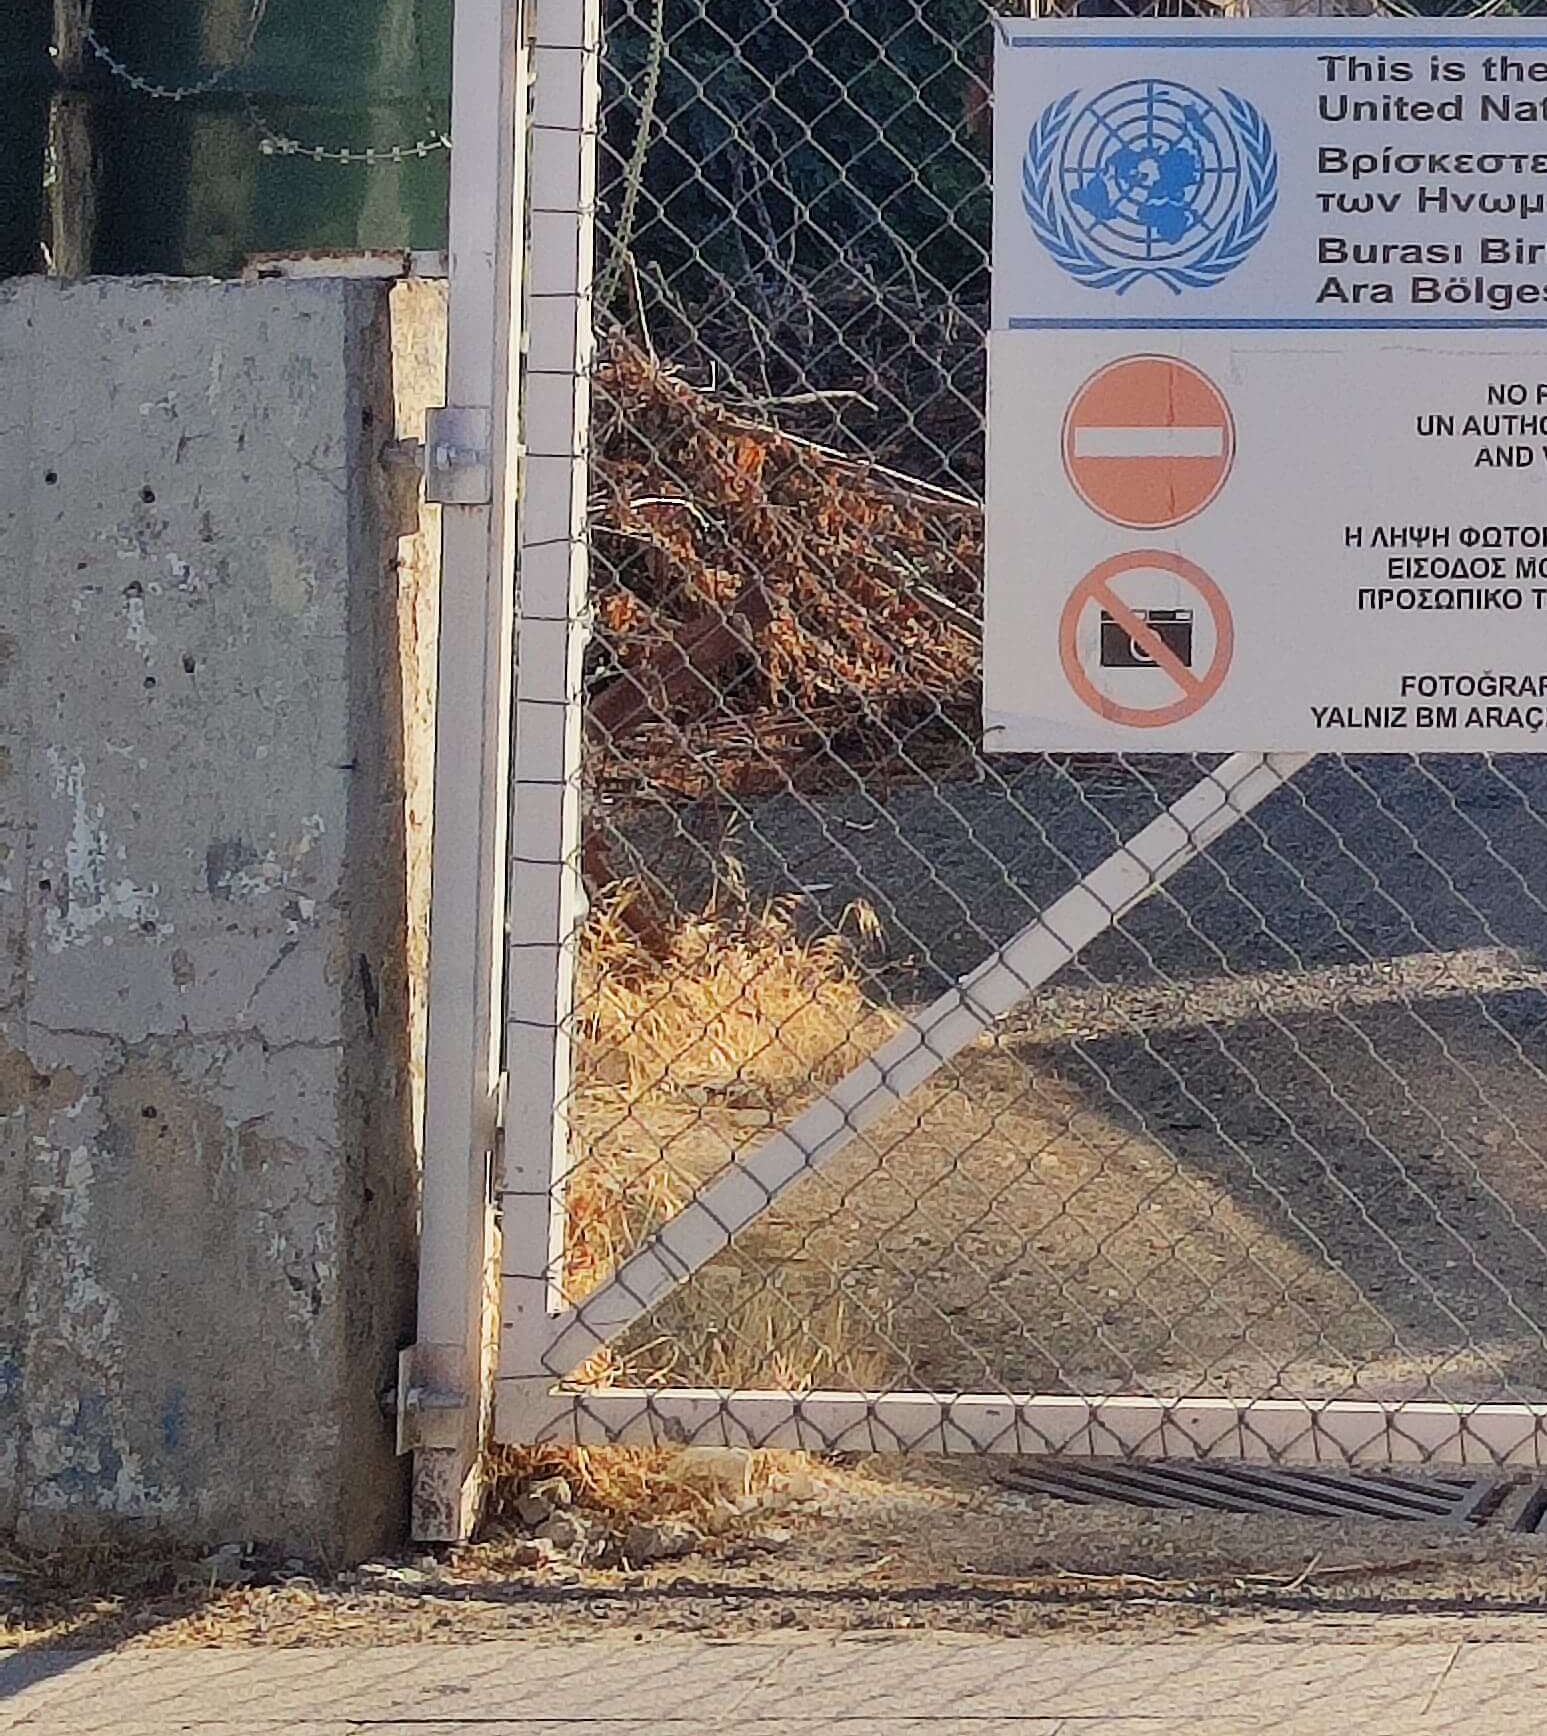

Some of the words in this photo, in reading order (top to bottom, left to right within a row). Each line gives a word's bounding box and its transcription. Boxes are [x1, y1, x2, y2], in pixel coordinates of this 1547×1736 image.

[1317, 55, 1413, 81] This
[1431, 56, 1465, 81] is
[1319, 95, 1462, 121] United
[1316, 193, 1401, 213] των
[1319, 238, 1461, 264] Burası
[1316, 277, 1393, 303] Ara
[1488, 384, 1527, 405] NO
[1417, 415, 1454, 436] UN
[1474, 446, 1533, 467] AND
[1370, 526, 1449, 548] ΛΗΨΗ
[1389, 557, 1506, 579] ΕΙΣΟΔΟΣ
[1359, 589, 1522, 610] ΠΡΟΣΩΠΙΚΟ
[1310, 707, 1407, 728] YALNIZ
[1417, 707, 1457, 728] BM
